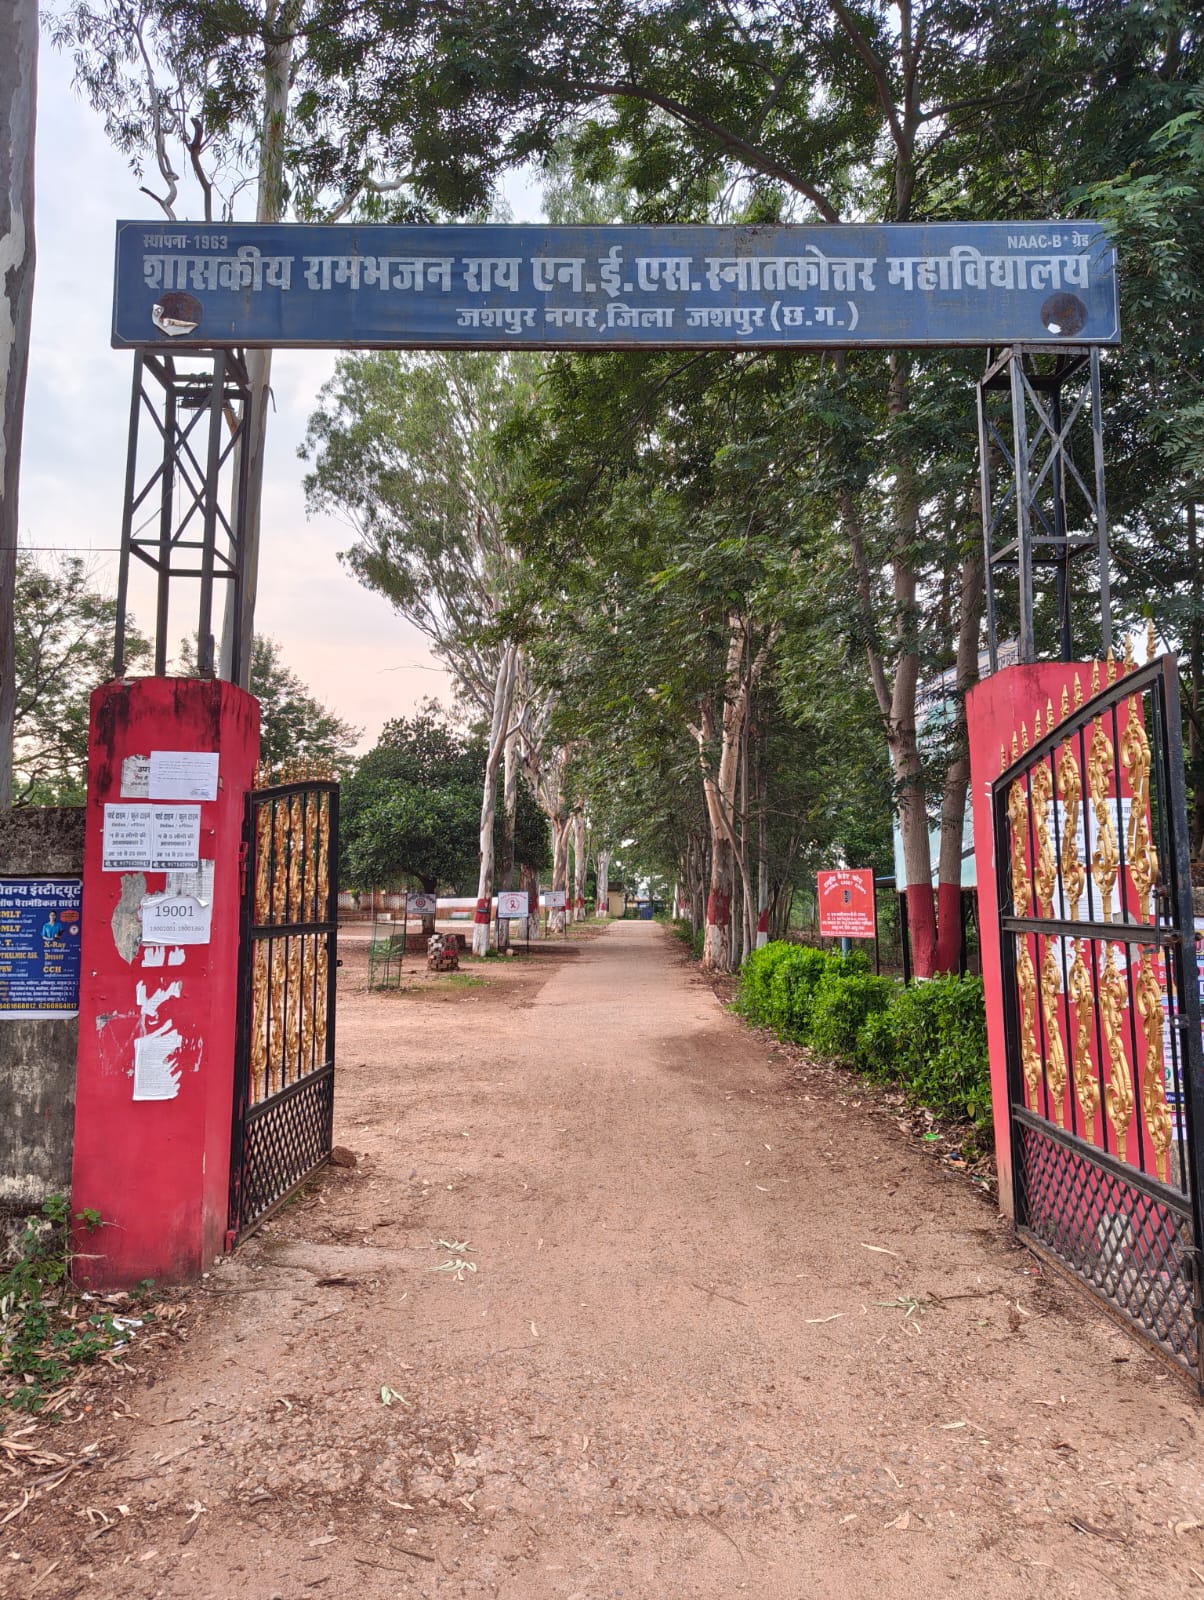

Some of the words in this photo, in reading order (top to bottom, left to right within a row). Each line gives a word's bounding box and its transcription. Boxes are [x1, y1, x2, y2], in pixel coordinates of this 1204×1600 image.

[143, 245, 295, 291] शासकीय
[302, 255, 455, 292] रामभजन
[462, 257, 523, 292] राय
[886, 245, 1091, 291] महाविद्यालय
[456, 308, 537, 334] जशपुर
[685, 308, 766, 335] जशपुर
[155, 905, 195, 917] 19001
